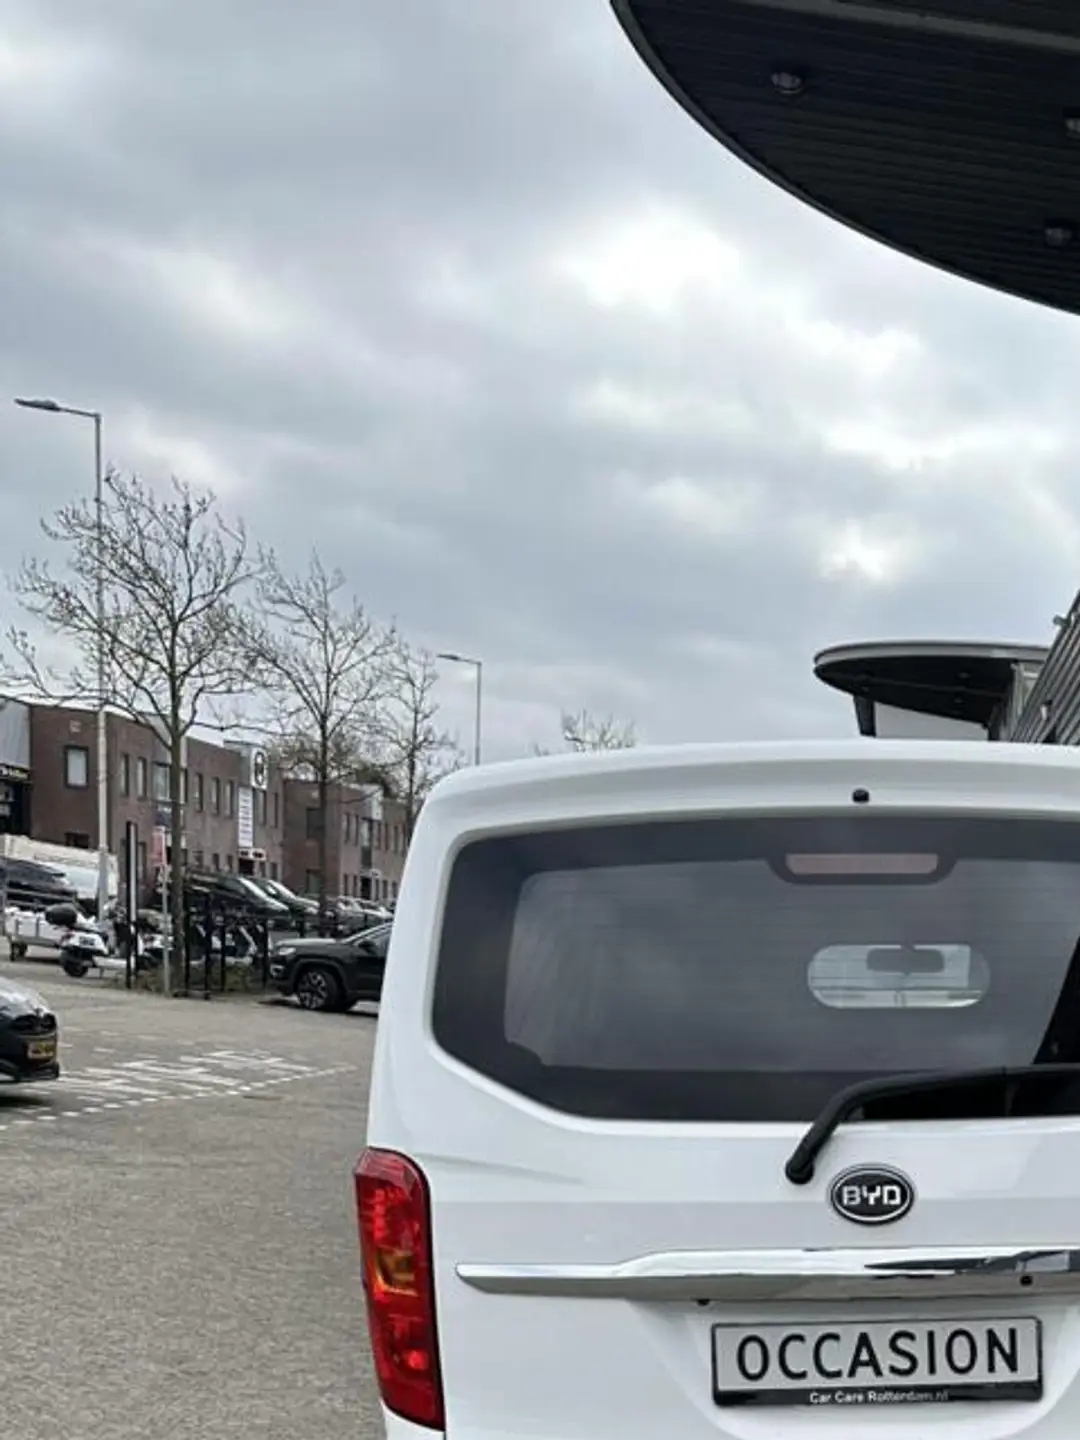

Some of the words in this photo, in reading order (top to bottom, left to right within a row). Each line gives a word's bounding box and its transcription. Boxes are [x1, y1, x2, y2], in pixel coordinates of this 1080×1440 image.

[842, 1184, 902, 1206] BYD
[736, 1327, 1019, 1382] OCCASION
[809, 1391, 832, 1405] Car
[834, 1390, 864, 1404] Care
[867, 1389, 950, 1404] Rotterdam.nl
